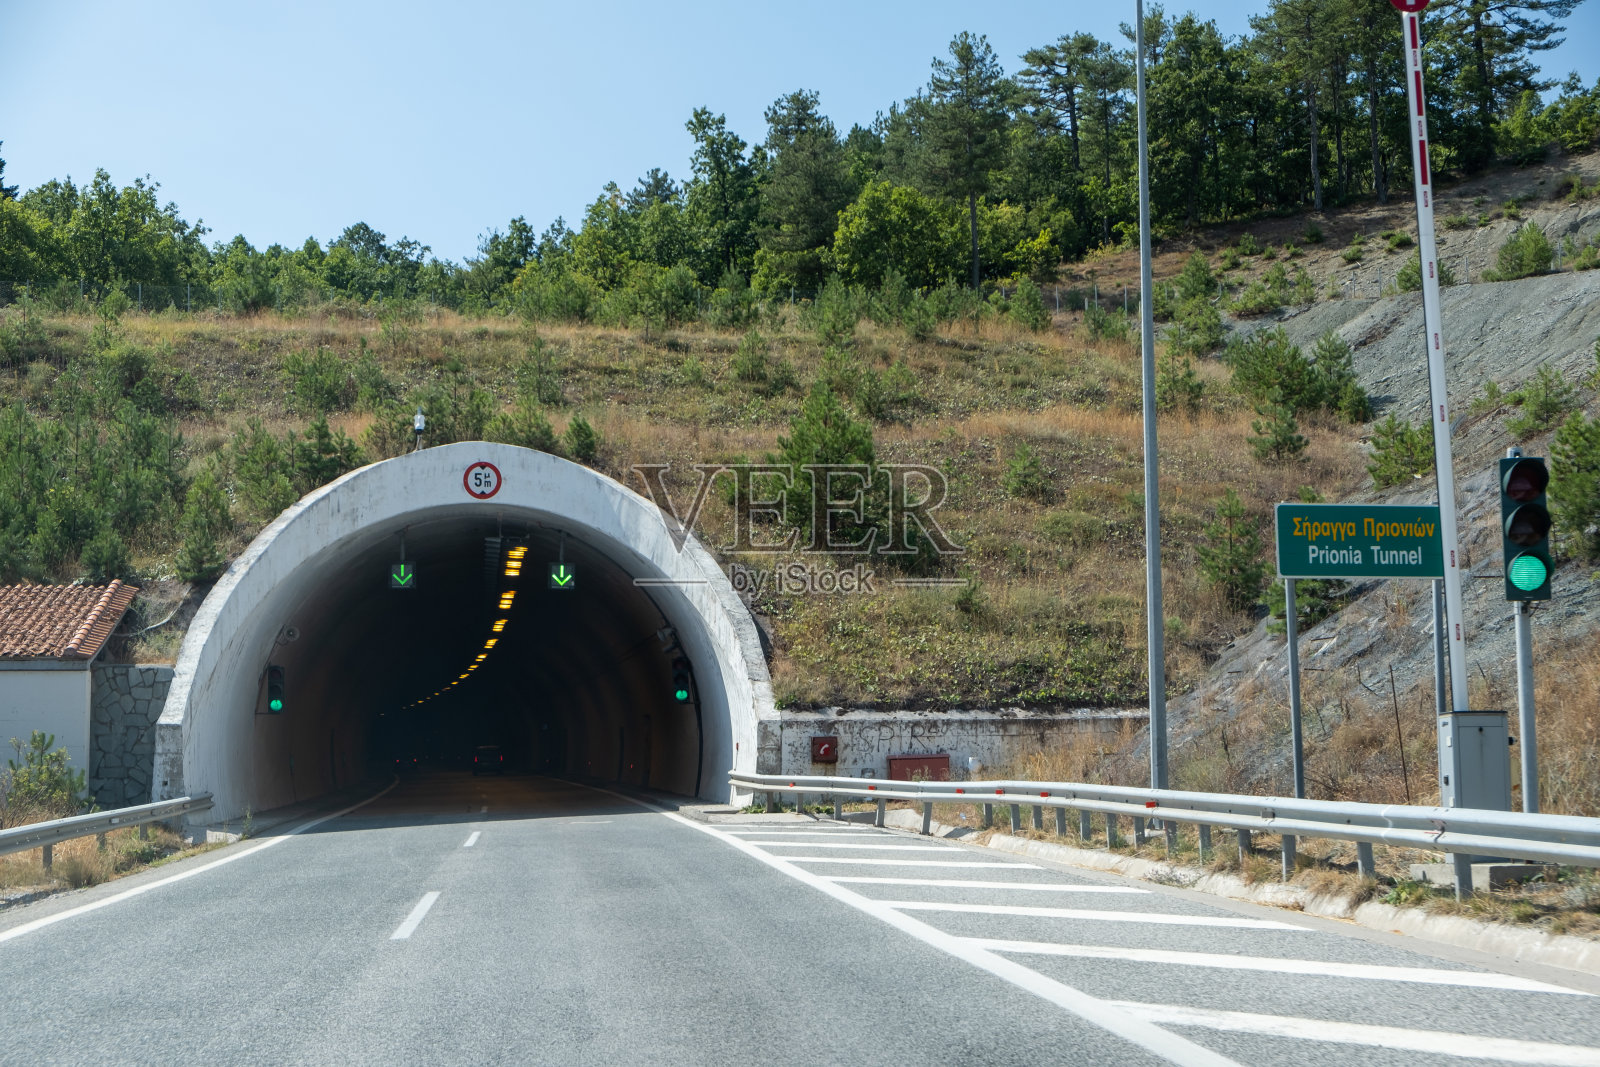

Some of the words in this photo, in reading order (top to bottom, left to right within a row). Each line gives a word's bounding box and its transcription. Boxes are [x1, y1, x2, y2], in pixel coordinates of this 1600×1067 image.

[474, 472, 483, 488] 5
[1292, 516, 1357, 542] Σήραγγα
[1363, 517, 1435, 542] Πριονιών
[1308, 545, 1363, 565] Prionia
[1370, 545, 1423, 565] Tunnel
